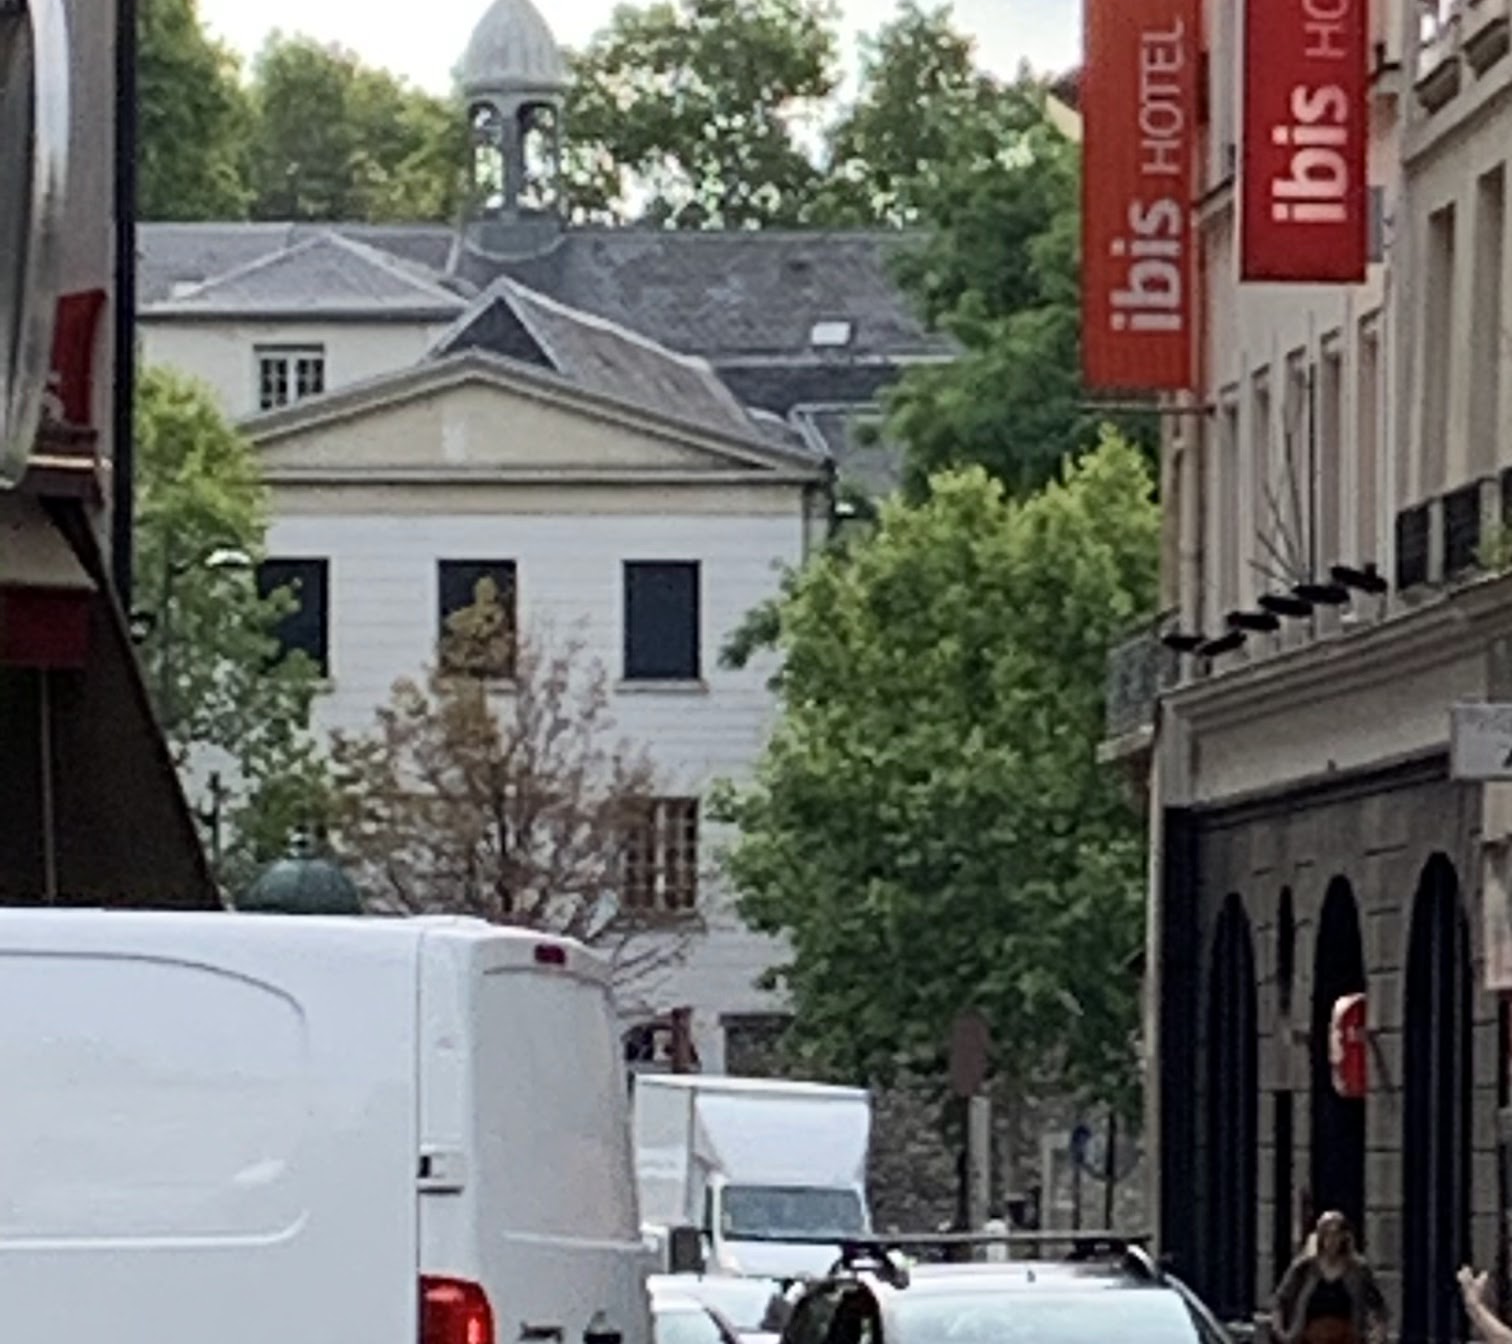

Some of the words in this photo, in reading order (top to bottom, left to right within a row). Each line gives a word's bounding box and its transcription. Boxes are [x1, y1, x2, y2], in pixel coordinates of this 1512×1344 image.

[1138, 16, 1185, 176] HOTEL
[1273, 84, 1349, 221] ibis
[1110, 197, 1184, 331] ibis
